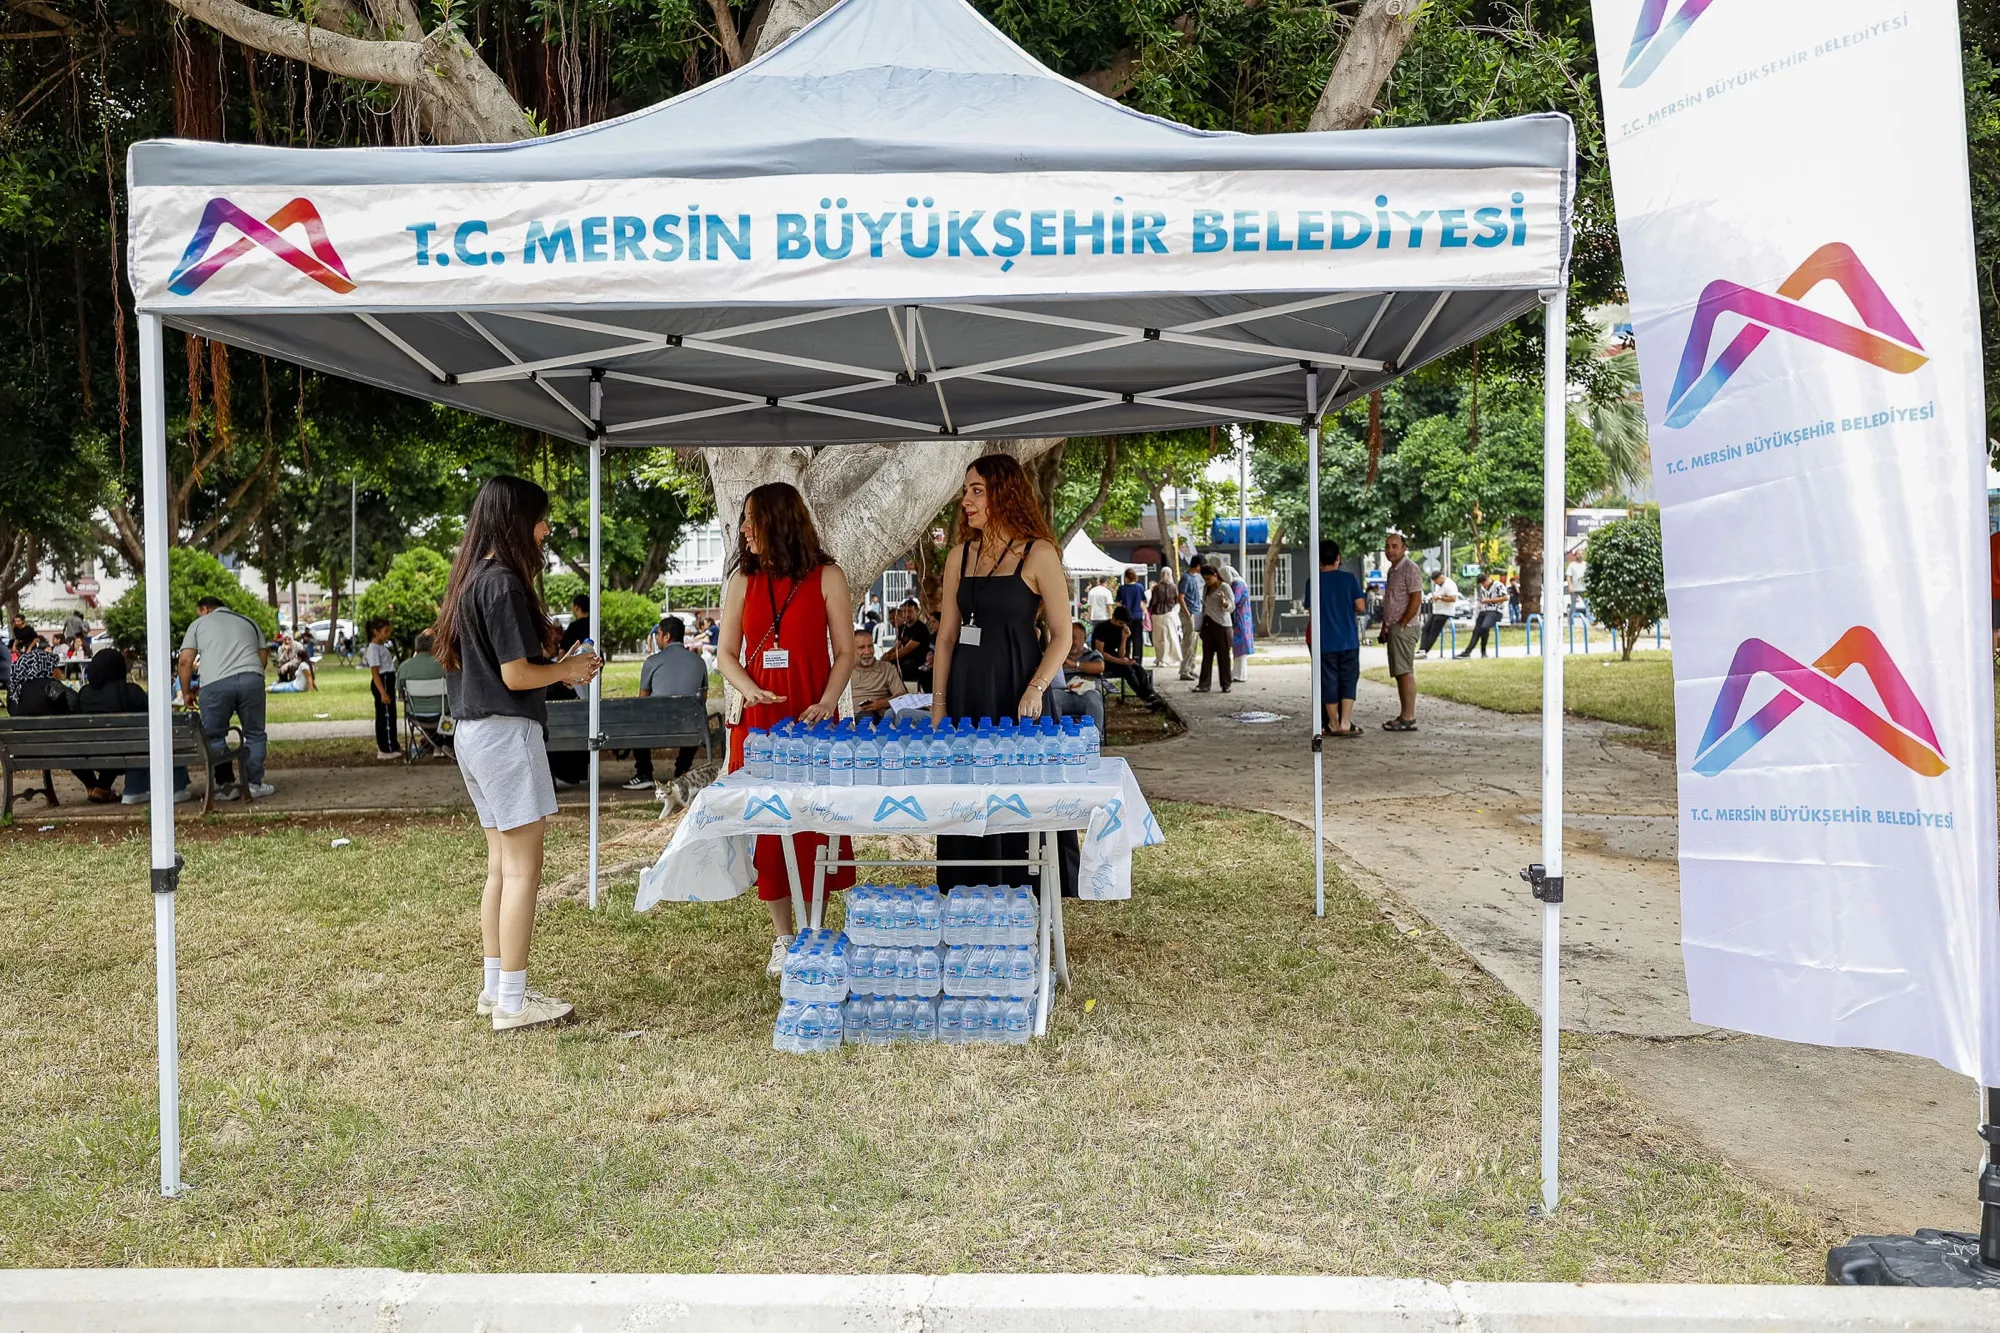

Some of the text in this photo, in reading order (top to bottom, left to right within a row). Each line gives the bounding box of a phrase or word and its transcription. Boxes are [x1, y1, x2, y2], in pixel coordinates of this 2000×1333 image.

[1647, 92, 1702, 126] MERSİN
[1706, 50, 1809, 99] BÜYÜKŞEHİR
[1814, 10, 1910, 58] BELEDİYESİ
[406, 191, 1528, 274] T.C. MERSİN BÜYÜKŞEHİR BELEDİYESİ
[1666, 400, 1936, 475] T.C. MERSİN BÜYÜKŞEHİR BELEDİYESİ
[1691, 804, 1954, 830] T.C. MERSİN BÜYÜKŞEHİR BELEDİYESİ
